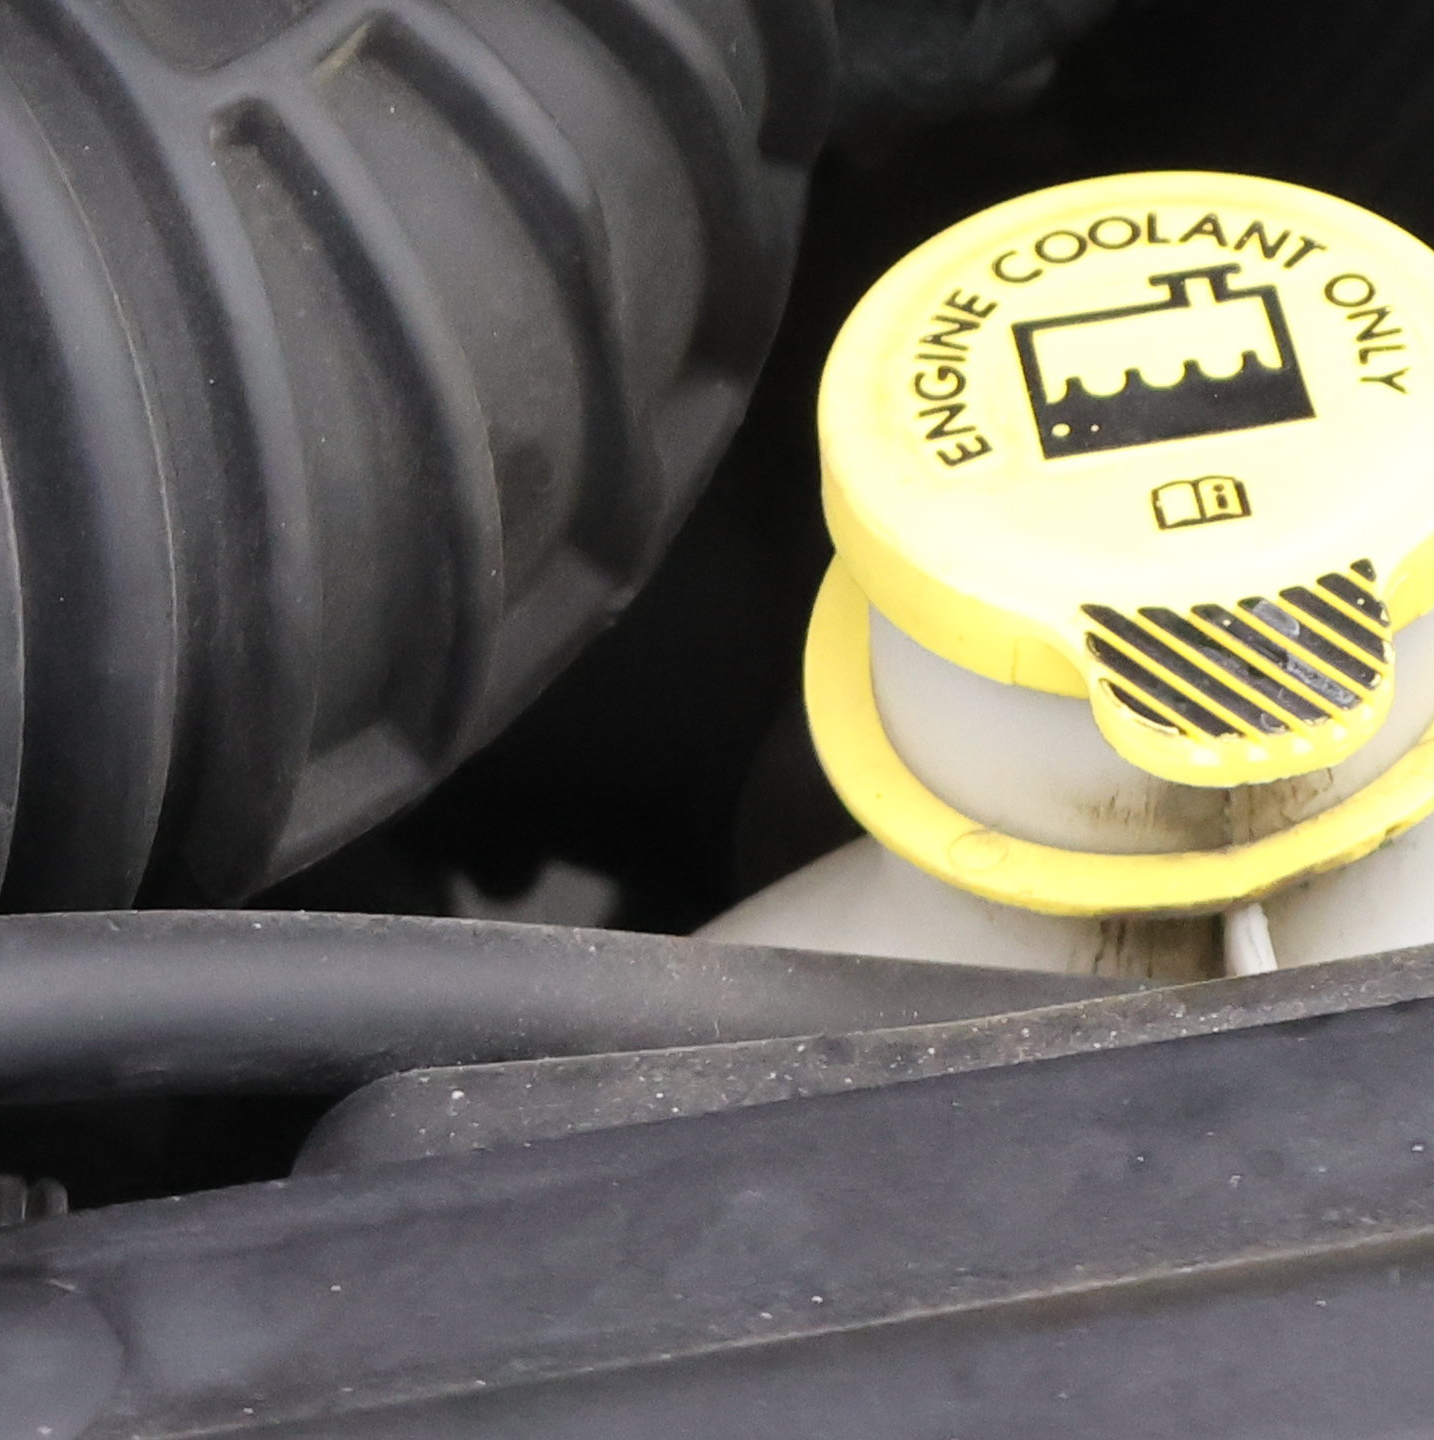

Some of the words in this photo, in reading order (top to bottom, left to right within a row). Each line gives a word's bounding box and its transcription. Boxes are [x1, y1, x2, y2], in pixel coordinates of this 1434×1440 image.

[915, 289, 997, 467] ENGINE
[992, 213, 1327, 285] COOLANT
[1323, 273, 1410, 395] ONLY
